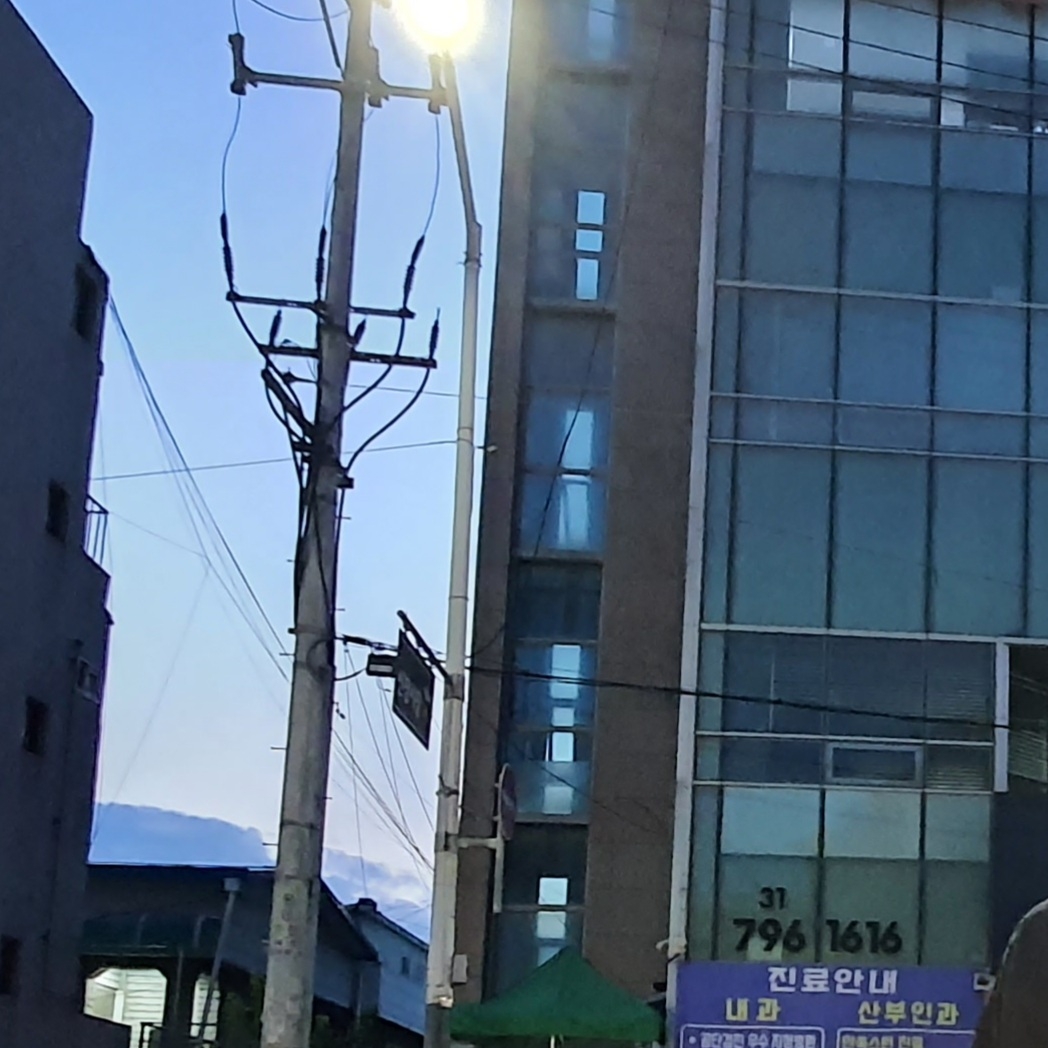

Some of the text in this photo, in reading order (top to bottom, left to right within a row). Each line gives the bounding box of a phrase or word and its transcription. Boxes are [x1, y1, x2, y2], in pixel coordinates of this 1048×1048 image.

[758, 887, 787, 910] 31
[733, 918, 903, 954] 796 1616
[767, 966, 899, 995] 진료안내
[725, 997, 782, 1023] 내과
[857, 1001, 960, 1026] 산부인과
